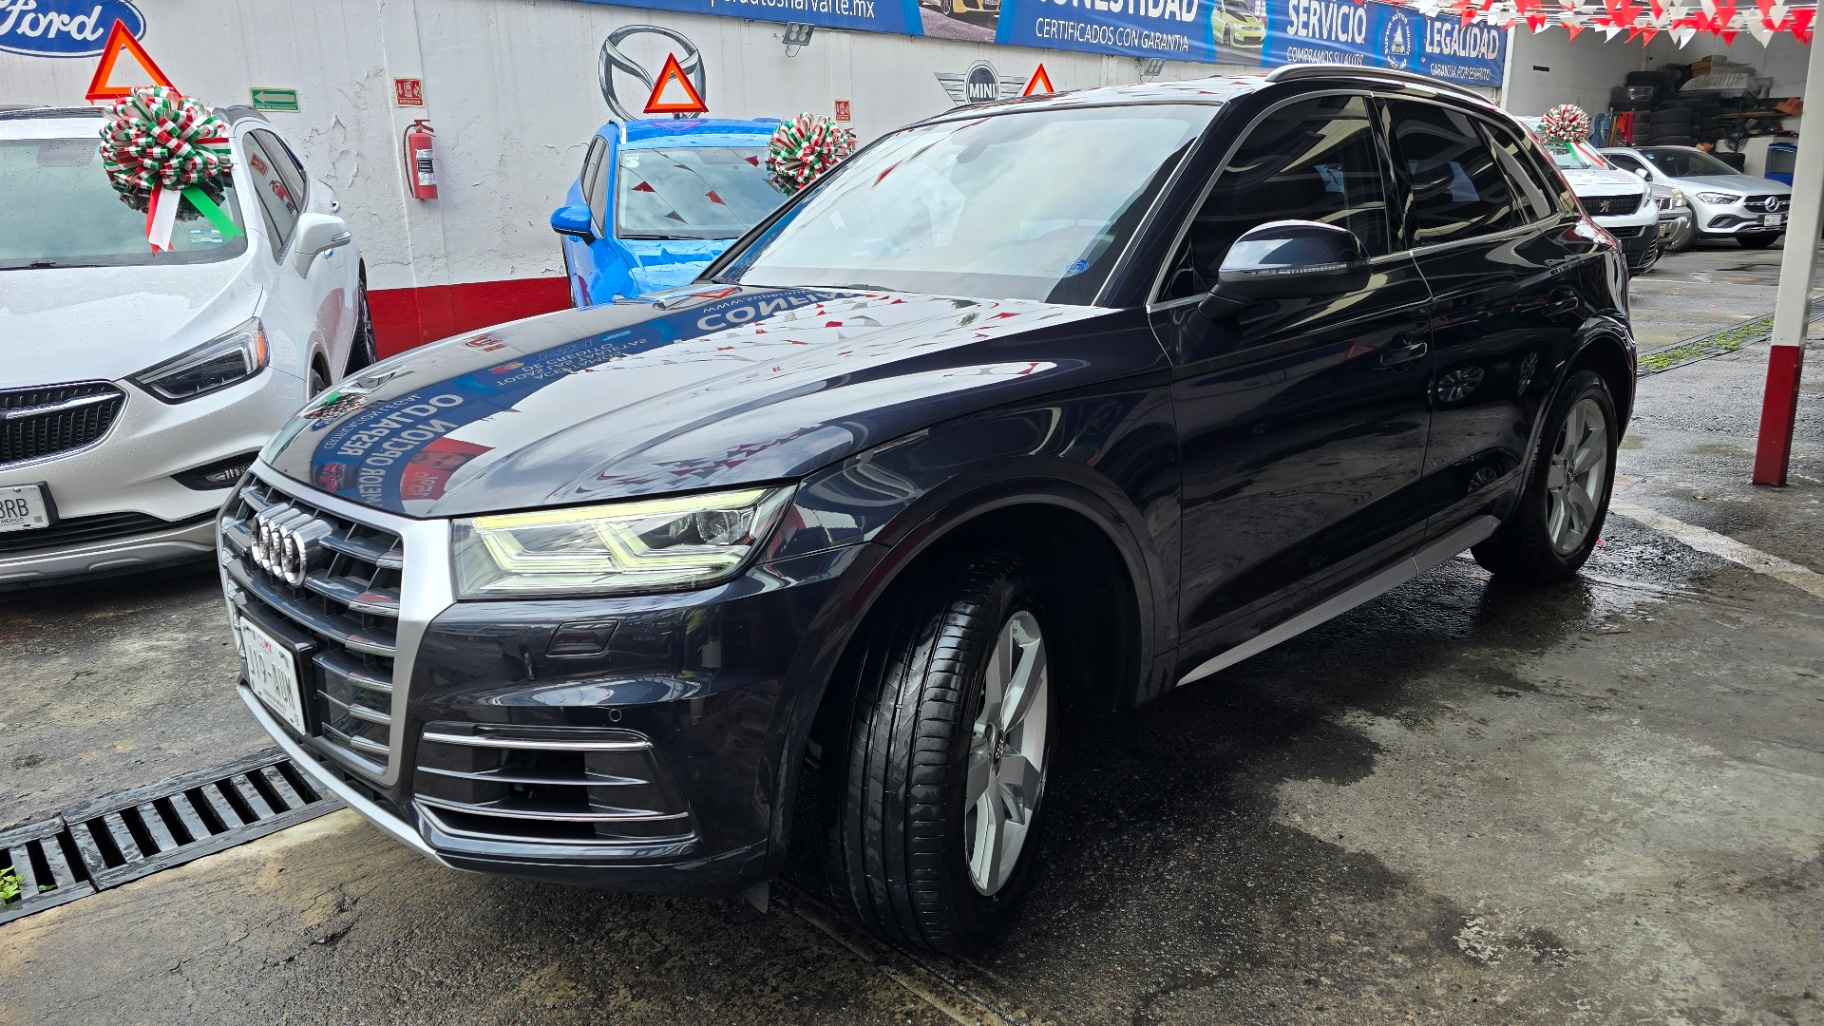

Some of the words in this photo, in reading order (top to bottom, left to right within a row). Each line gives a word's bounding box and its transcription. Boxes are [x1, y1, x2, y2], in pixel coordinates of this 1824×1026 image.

[0, 0, 104, 41] Ford
[1035, 17, 1114, 45] CERTIFICADOS
[1116, 28, 1139, 47] CON
[1141, 30, 1189, 52] GARANTIA
[1287, 0, 1367, 44] SERVICIO
[1426, 19, 1500, 60] LEGALIDAD
[970, 83, 996, 98] MINI
